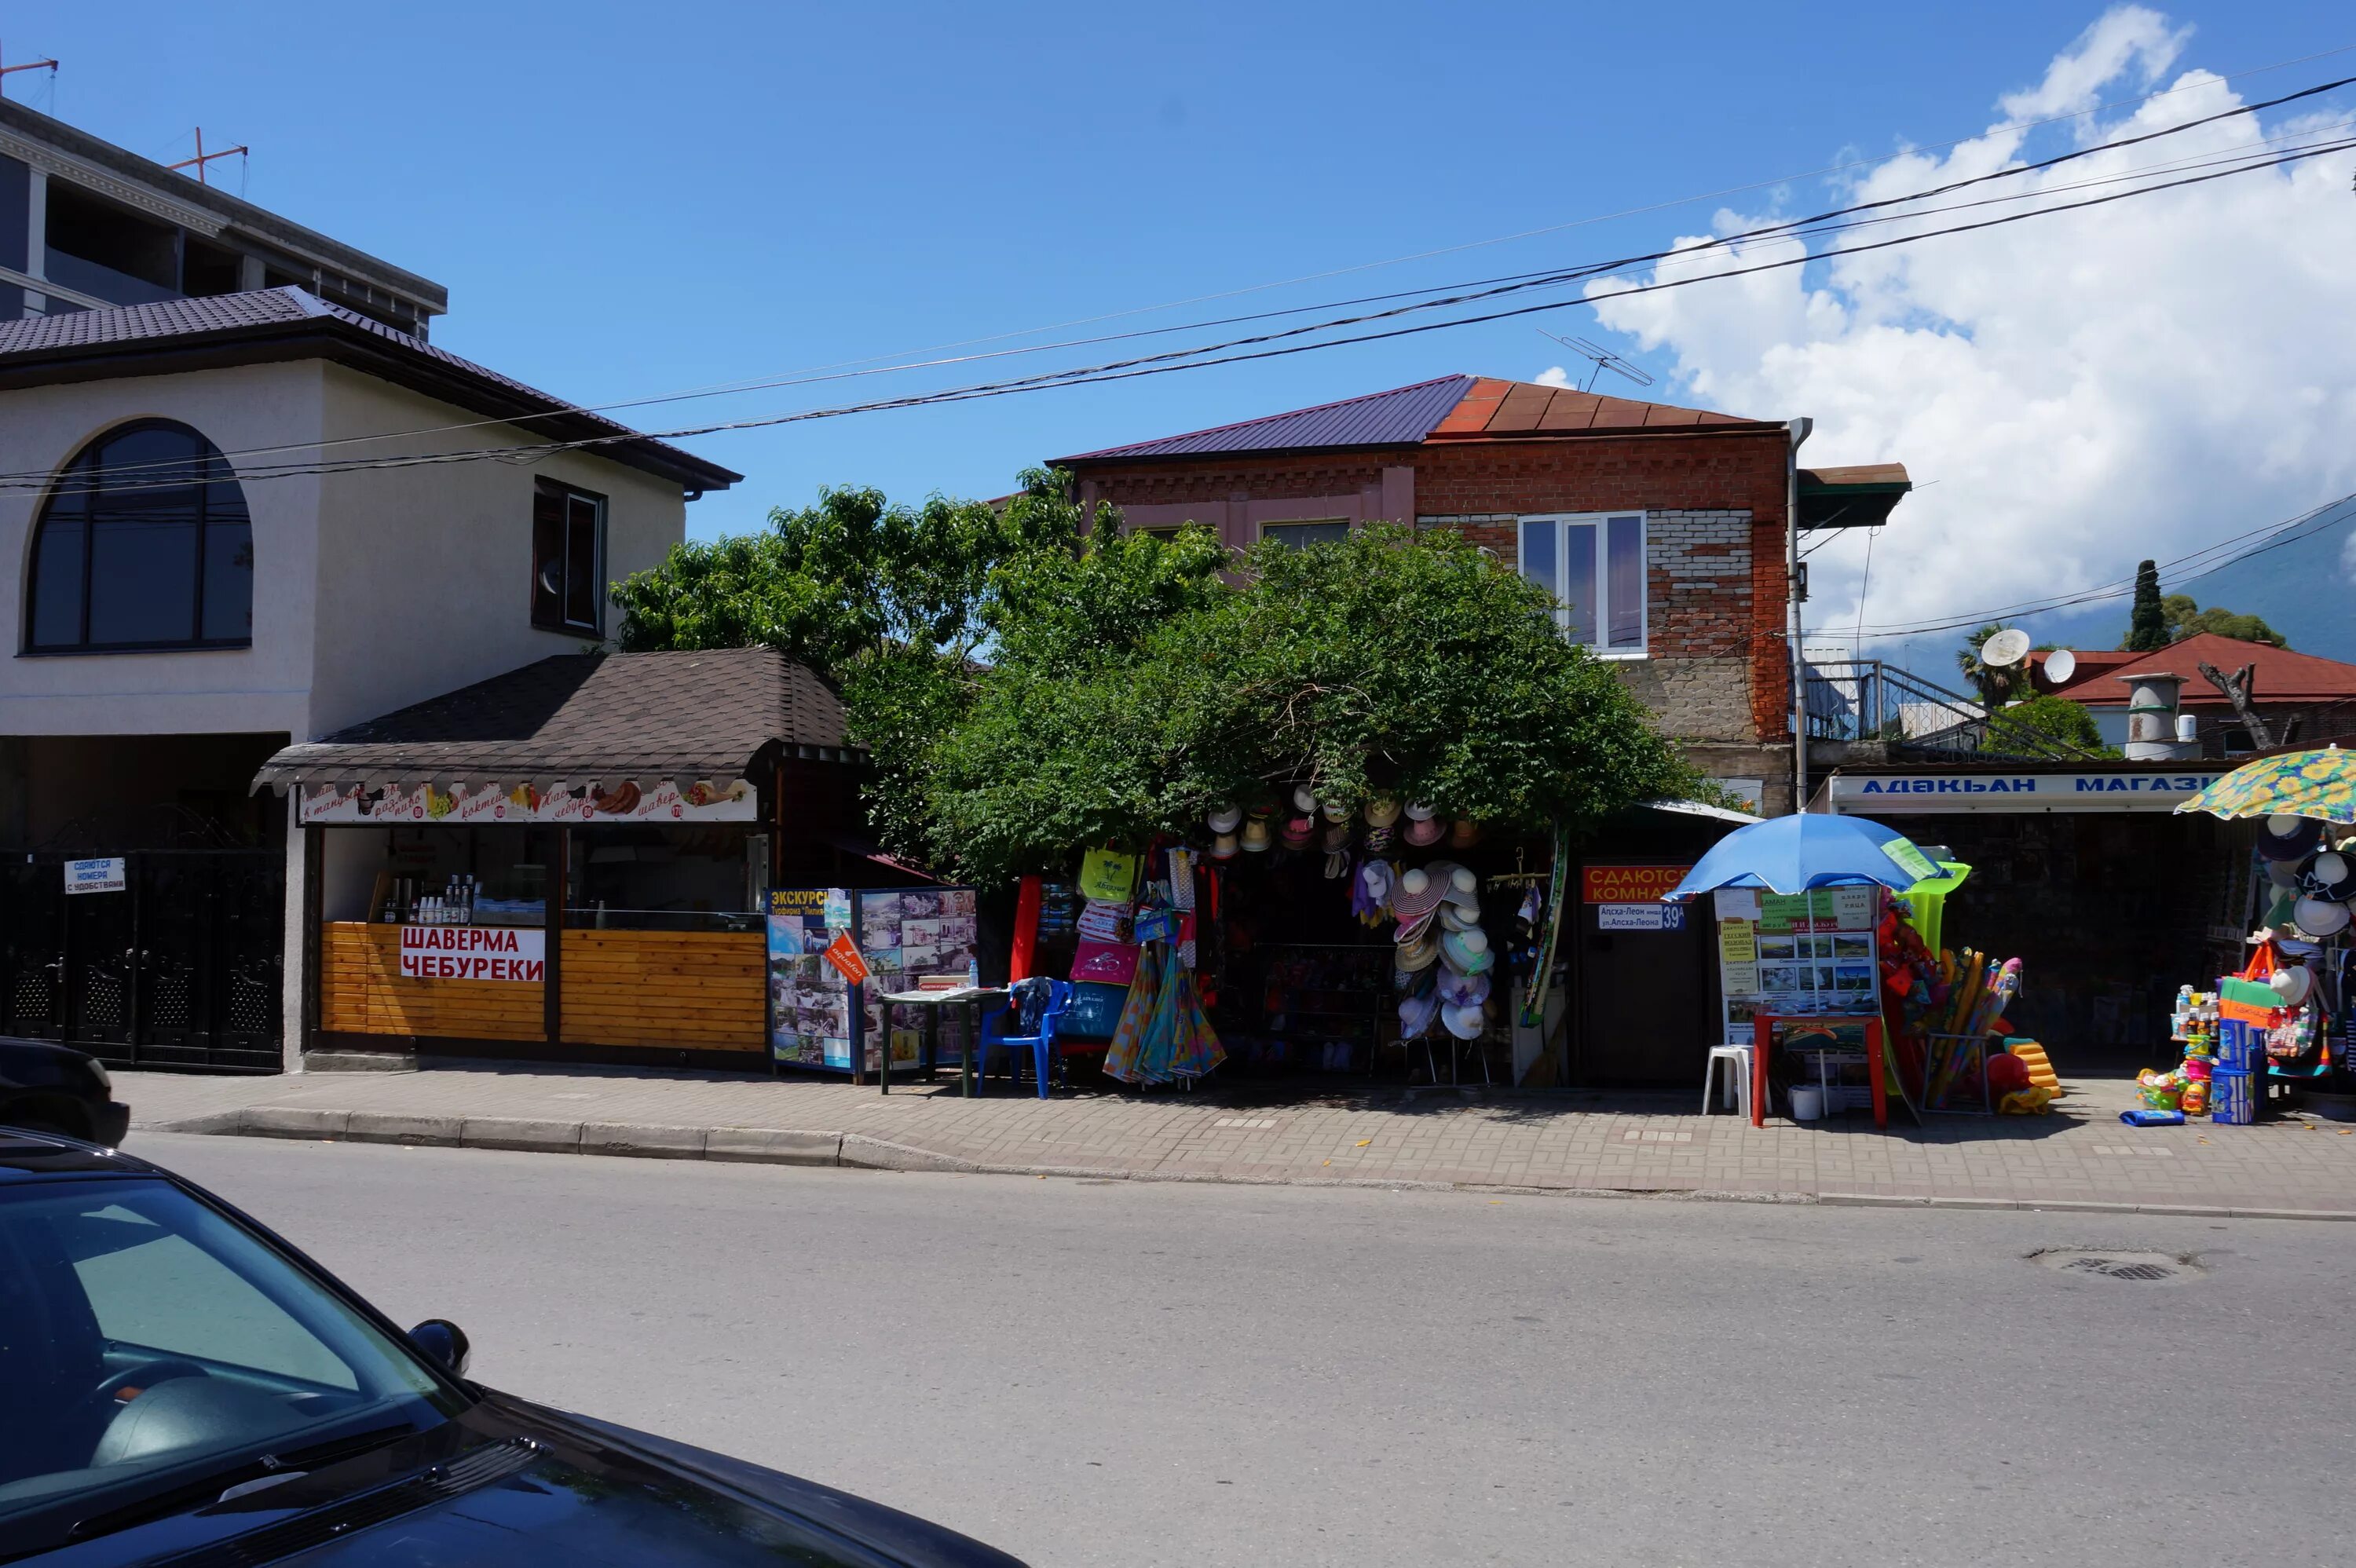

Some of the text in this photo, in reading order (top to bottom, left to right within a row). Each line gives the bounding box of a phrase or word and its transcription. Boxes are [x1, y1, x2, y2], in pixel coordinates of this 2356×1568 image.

[462, 790, 504, 819] коктей
[638, 792, 679, 816] шавер
[75, 860, 111, 870] СДАЮТСЯ
[77, 871, 108, 880] НОМЕРА
[75, 880, 123, 891] УДОБСТВАМИ
[1593, 887, 1675, 899] КОМНАТ
[772, 906, 801, 916] Турфирма
[403, 928, 518, 952] ШАВЕРМА
[403, 956, 543, 981] ЧЕБУРЕКИ
[832, 948, 862, 977] aquafon
